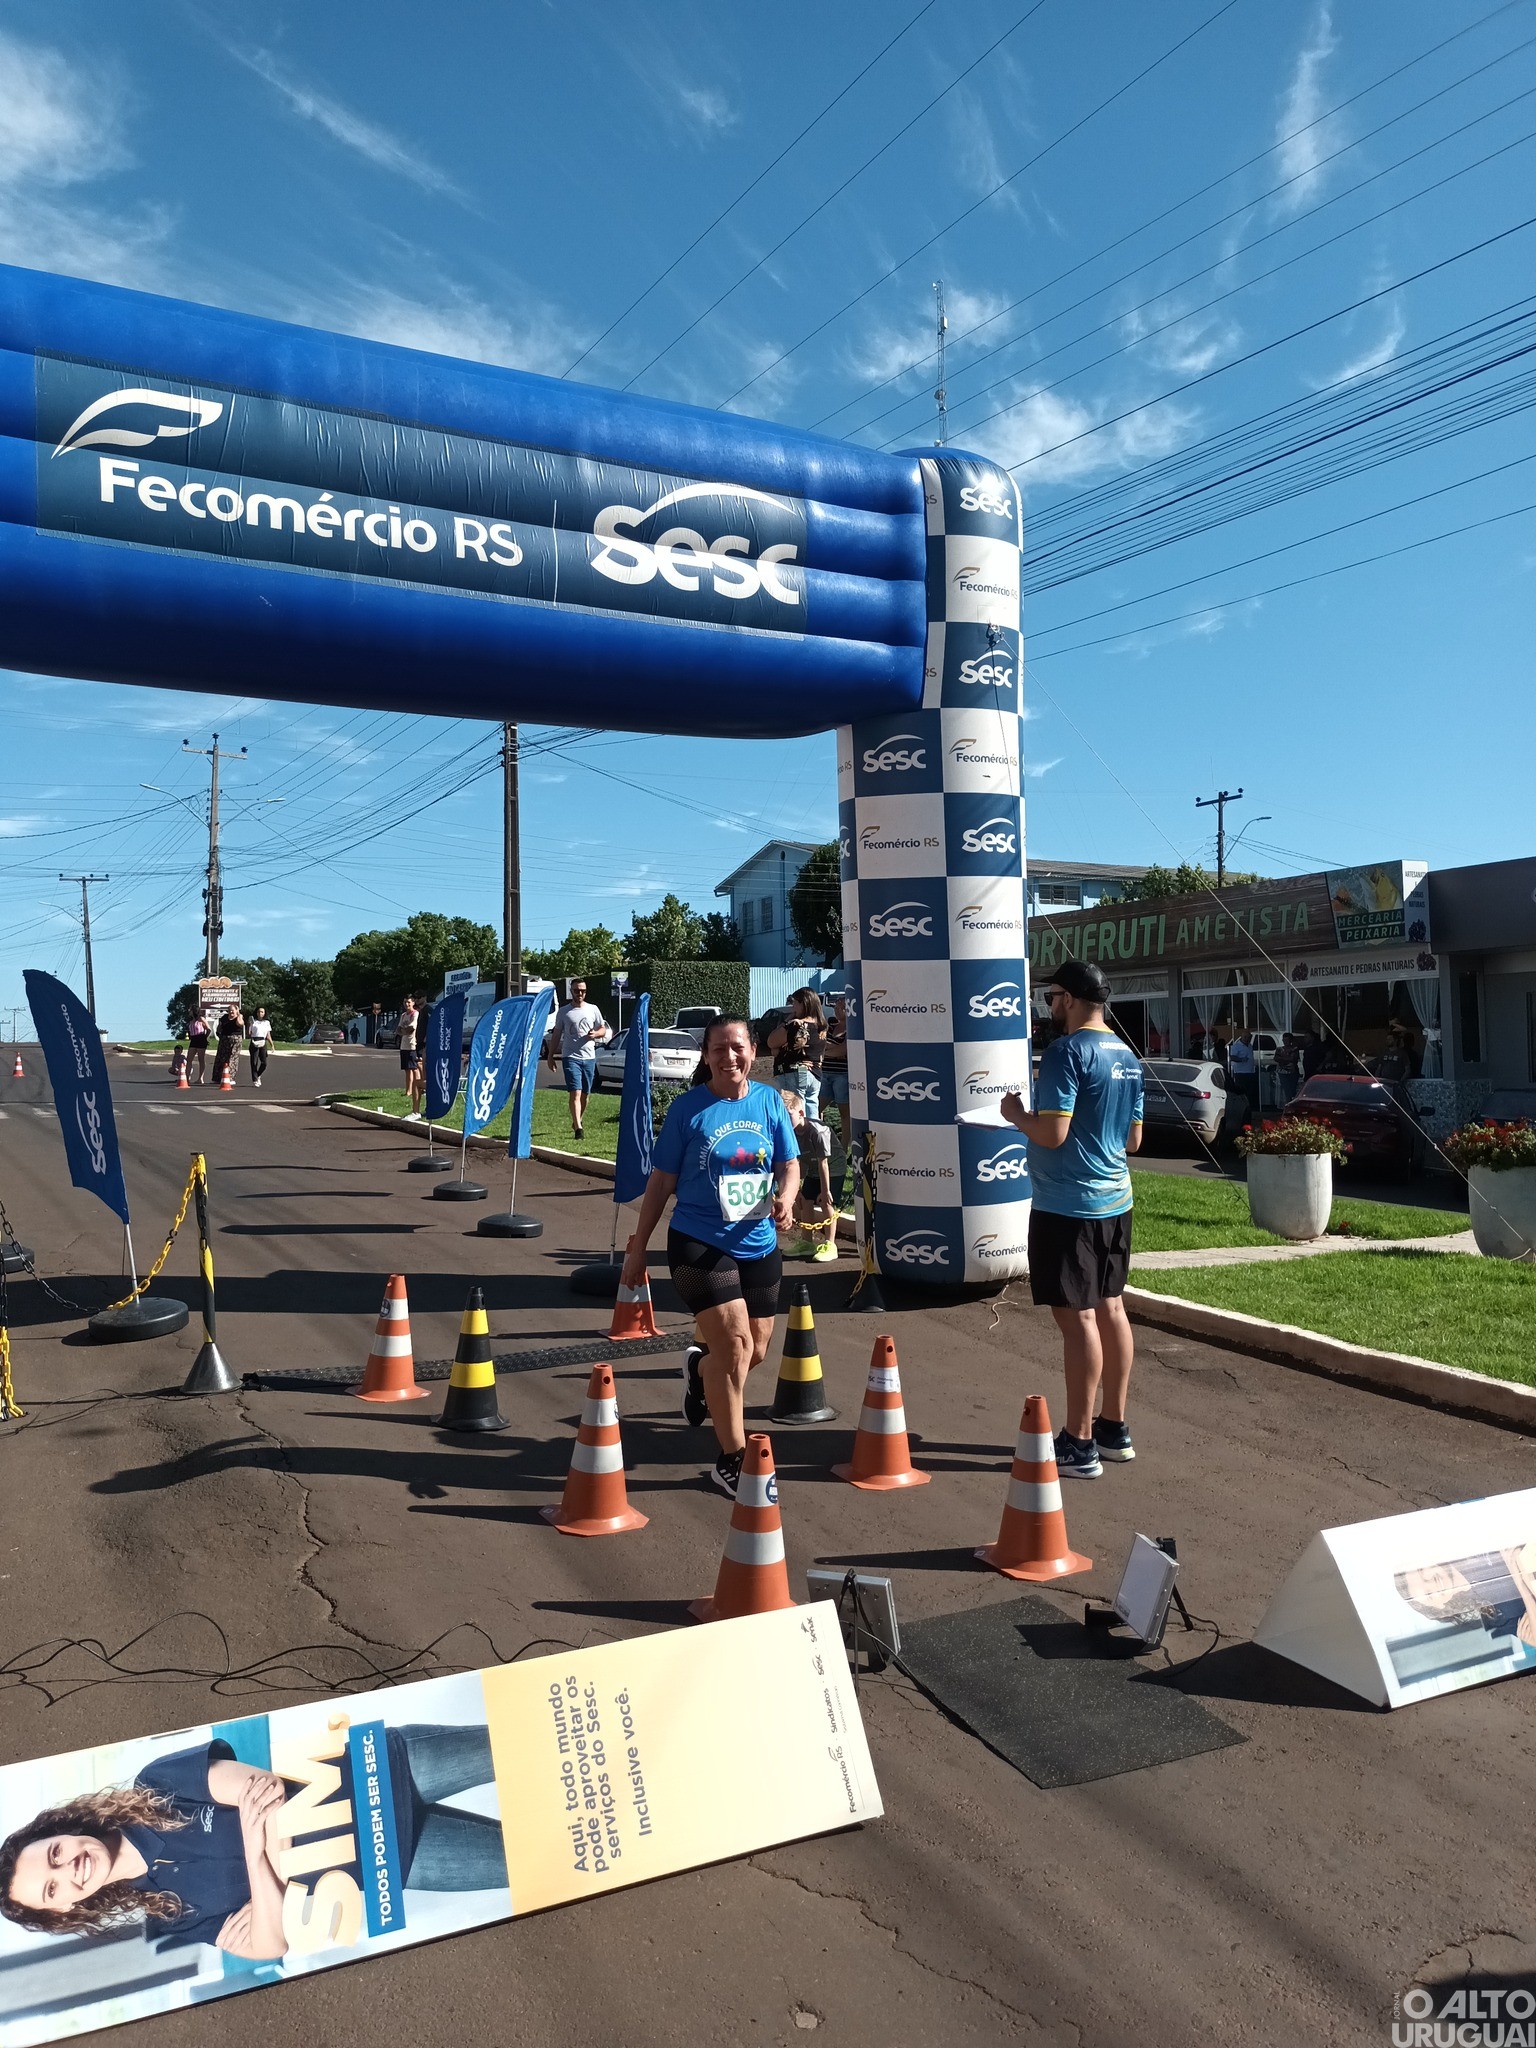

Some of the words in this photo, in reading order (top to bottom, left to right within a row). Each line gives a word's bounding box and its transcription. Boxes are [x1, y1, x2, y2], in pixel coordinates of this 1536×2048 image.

[99, 456, 437, 554] Fecomércio
[455, 516, 524, 568] RS
[590, 500, 801, 606] Sesc
[959, 580, 1011, 597] Fecomércio
[958, 658, 1013, 689] Sesc
[862, 745, 927, 773] Sesc
[955, 752, 1009, 765] Fecomércio
[863, 837, 921, 851] Fecomércio
[923, 836, 940, 848] RS
[961, 826, 1016, 855] Sesc
[868, 912, 934, 938] Sesc
[962, 919, 1014, 931] Fecomércio
[1337, 910, 1403, 927] MERCEARIA
[1346, 925, 1400, 941] PEIXARIA
[1028, 914, 1166, 968] ORTIFRUTI
[1175, 902, 1309, 946] AMETISTA
[1309, 964, 1350, 978] ARTESANATO
[1350, 965, 1355, 974] E
[1356, 962, 1381, 974] PEDRAS
[1382, 959, 1415, 971] NATURAIS
[870, 1002, 928, 1015] Fecomércio
[930, 1003, 947, 1014] RS
[968, 991, 1022, 1018] Sesc
[60, 1003, 85, 1079] Fecomércio
[485, 1009, 504, 1059] Fecomércio
[440, 1058, 450, 1106] Sesc
[473, 1066, 499, 1122] Sesc
[876, 1074, 942, 1102] Sesc
[969, 1082, 1020, 1095] Fecomércio
[80, 1091, 107, 1176] Sesc
[699, 1135, 717, 1170] FAMÍLIA
[714, 1122, 732, 1137] QUE
[733, 1120, 763, 1132] CORRE
[878, 1162, 936, 1178] Fecomércio
[939, 1166, 955, 1178] RS
[727, 1179, 768, 1207] 584
[885, 1236, 950, 1265] Sesc
[978, 1243, 1028, 1258] Fecomércio
[565, 1675, 579, 1698] os
[548, 1683, 571, 1754] mundo
[584, 1681, 600, 1733] Sesc.
[615, 1687, 635, 1740] você.
[363, 1729, 377, 1774] SESC.
[569, 1705, 598, 1810] aproveitar
[591, 1739, 607, 1766] do
[367, 1775, 382, 1807] SER
[560, 1760, 579, 1811] todo
[628, 1746, 653, 1837] Inclusive
[840, 1760, 857, 1814] Fecomércio
[203, 1805, 215, 1833] Sesc
[598, 1772, 622, 1859] serviços
[368, 1808, 387, 1867] PODEM
[568, 1816, 590, 1873] Aqui,
[586, 1817, 610, 1873] pode
[376, 1868, 393, 1926] TODOS
